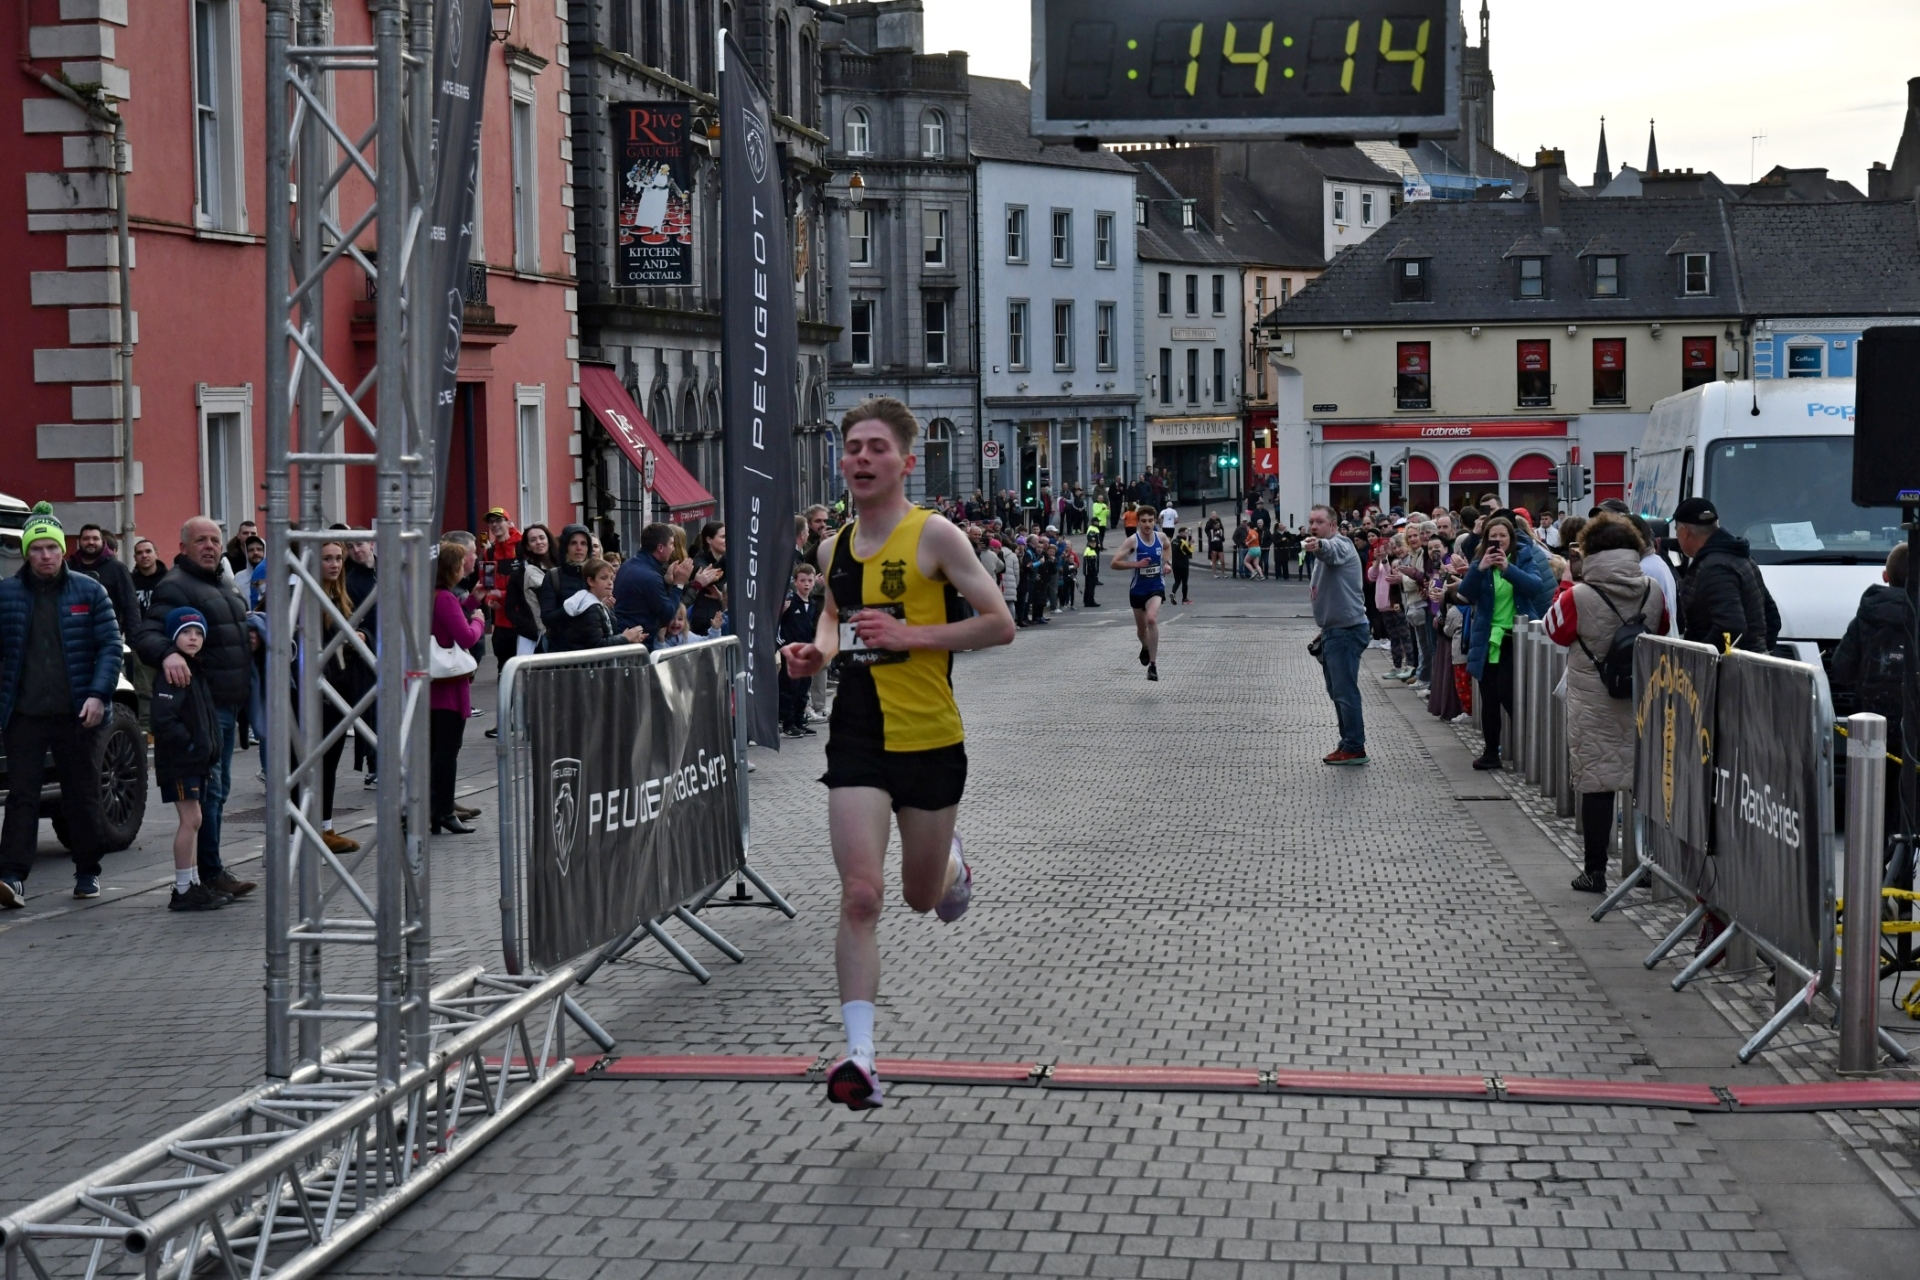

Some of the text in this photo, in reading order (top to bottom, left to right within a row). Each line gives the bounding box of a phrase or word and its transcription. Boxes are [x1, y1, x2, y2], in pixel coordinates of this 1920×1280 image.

[627, 108, 683, 145] Rive
[626, 146, 682, 157] GAUCHE
[629, 247, 681, 257] KITCHEN
[642, 260, 669, 269] AND
[629, 271, 682, 280] COCKTAILS
[752, 196, 768, 450] PEUGEOT
[1807, 402, 1856, 420] Pop
[1160, 421, 1231, 436] WHITES PHARMACY
[1421, 426, 1472, 436] Ladbrokes
[1339, 469, 1370, 477] Ladbrokes
[1458, 467, 1489, 475] Ladbrokes
[746, 496, 760, 695] Race Series
[853, 653, 879, 662] Pop Up
[1740, 773, 1765, 829] Race
[1765, 784, 1800, 848] Series
